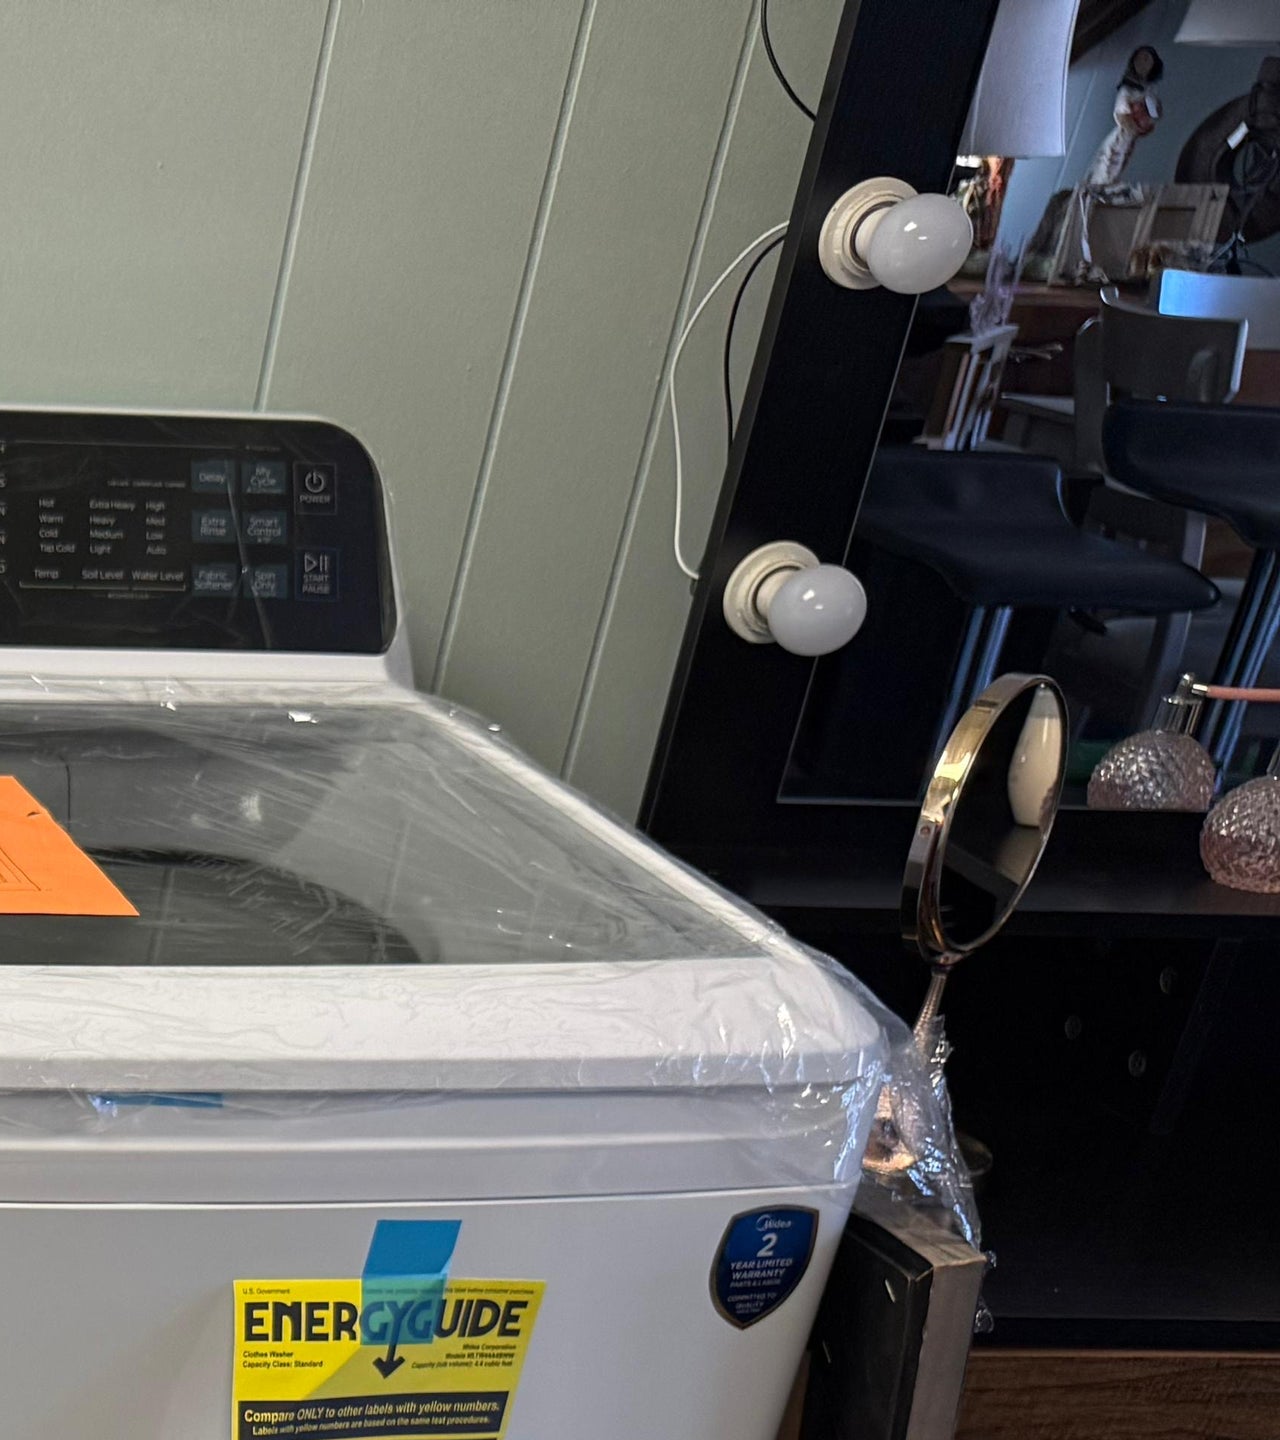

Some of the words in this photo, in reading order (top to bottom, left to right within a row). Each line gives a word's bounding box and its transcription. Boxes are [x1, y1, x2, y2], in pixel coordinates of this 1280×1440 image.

[39, 529, 58, 538] Cold
[757, 1233, 778, 1257] 2
[730, 1260, 756, 1270] YEAR
[756, 1258, 793, 1267] LIMITED
[732, 1268, 786, 1279] WARRANTY
[244, 1298, 529, 1343] ENERGYGUIDE
[243, 1360, 270, 1369] Capacity
[244, 1409, 294, 1424] Compare
[297, 1407, 325, 1420] ONLY
[325, 1408, 335, 1418] to
[338, 1404, 362, 1416] other
[365, 1403, 393, 1415] labels
[396, 1401, 416, 1413] with
[418, 1401, 451, 1415] yellow
[454, 1400, 499, 1412] numbers.
[252, 1426, 278, 1436] Labels
[280, 1425, 294, 1433] with
[295, 1423, 318, 1434] yellow
[319, 1421, 349, 1430] numbers
